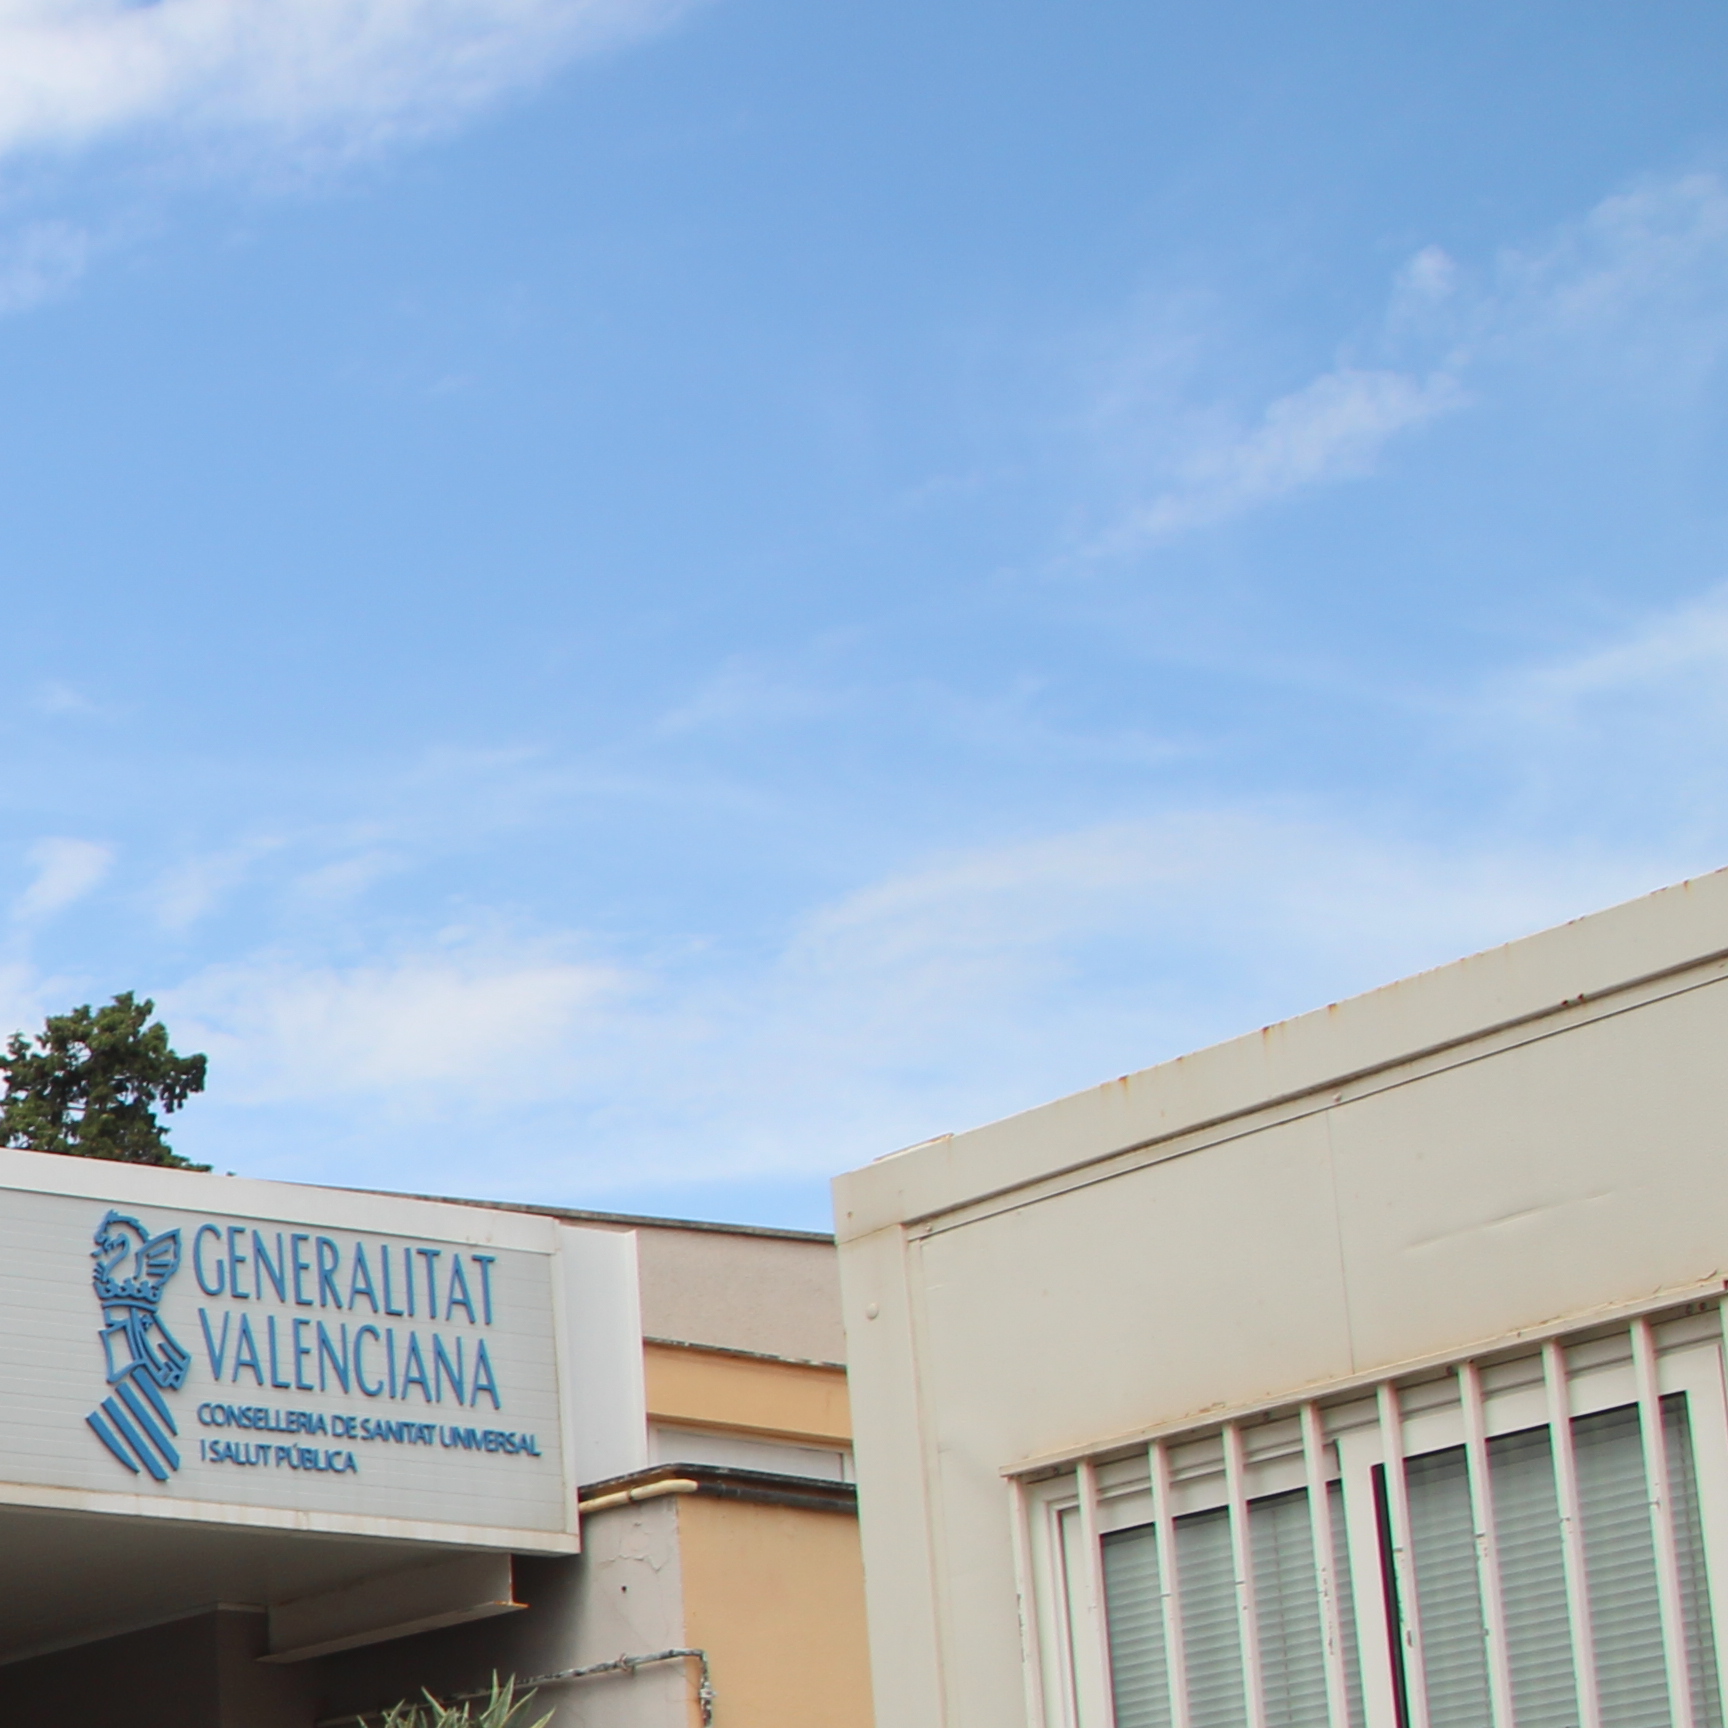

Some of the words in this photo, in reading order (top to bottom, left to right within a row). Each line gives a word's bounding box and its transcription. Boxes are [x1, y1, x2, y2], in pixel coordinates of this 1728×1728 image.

[192, 1223, 496, 1326] GENERALITAT
[198, 1306, 501, 1410] VALENCIANA
[196, 1401, 328, 1437] CONSELLERIA
[330, 1414, 359, 1439] DE
[360, 1417, 436, 1446] SANITAT
[439, 1424, 542, 1457] UNIVERSAL
[200, 1438, 207, 1461] I
[208, 1438, 272, 1466] SALUT
[275, 1441, 358, 1474] PÚBLICA
